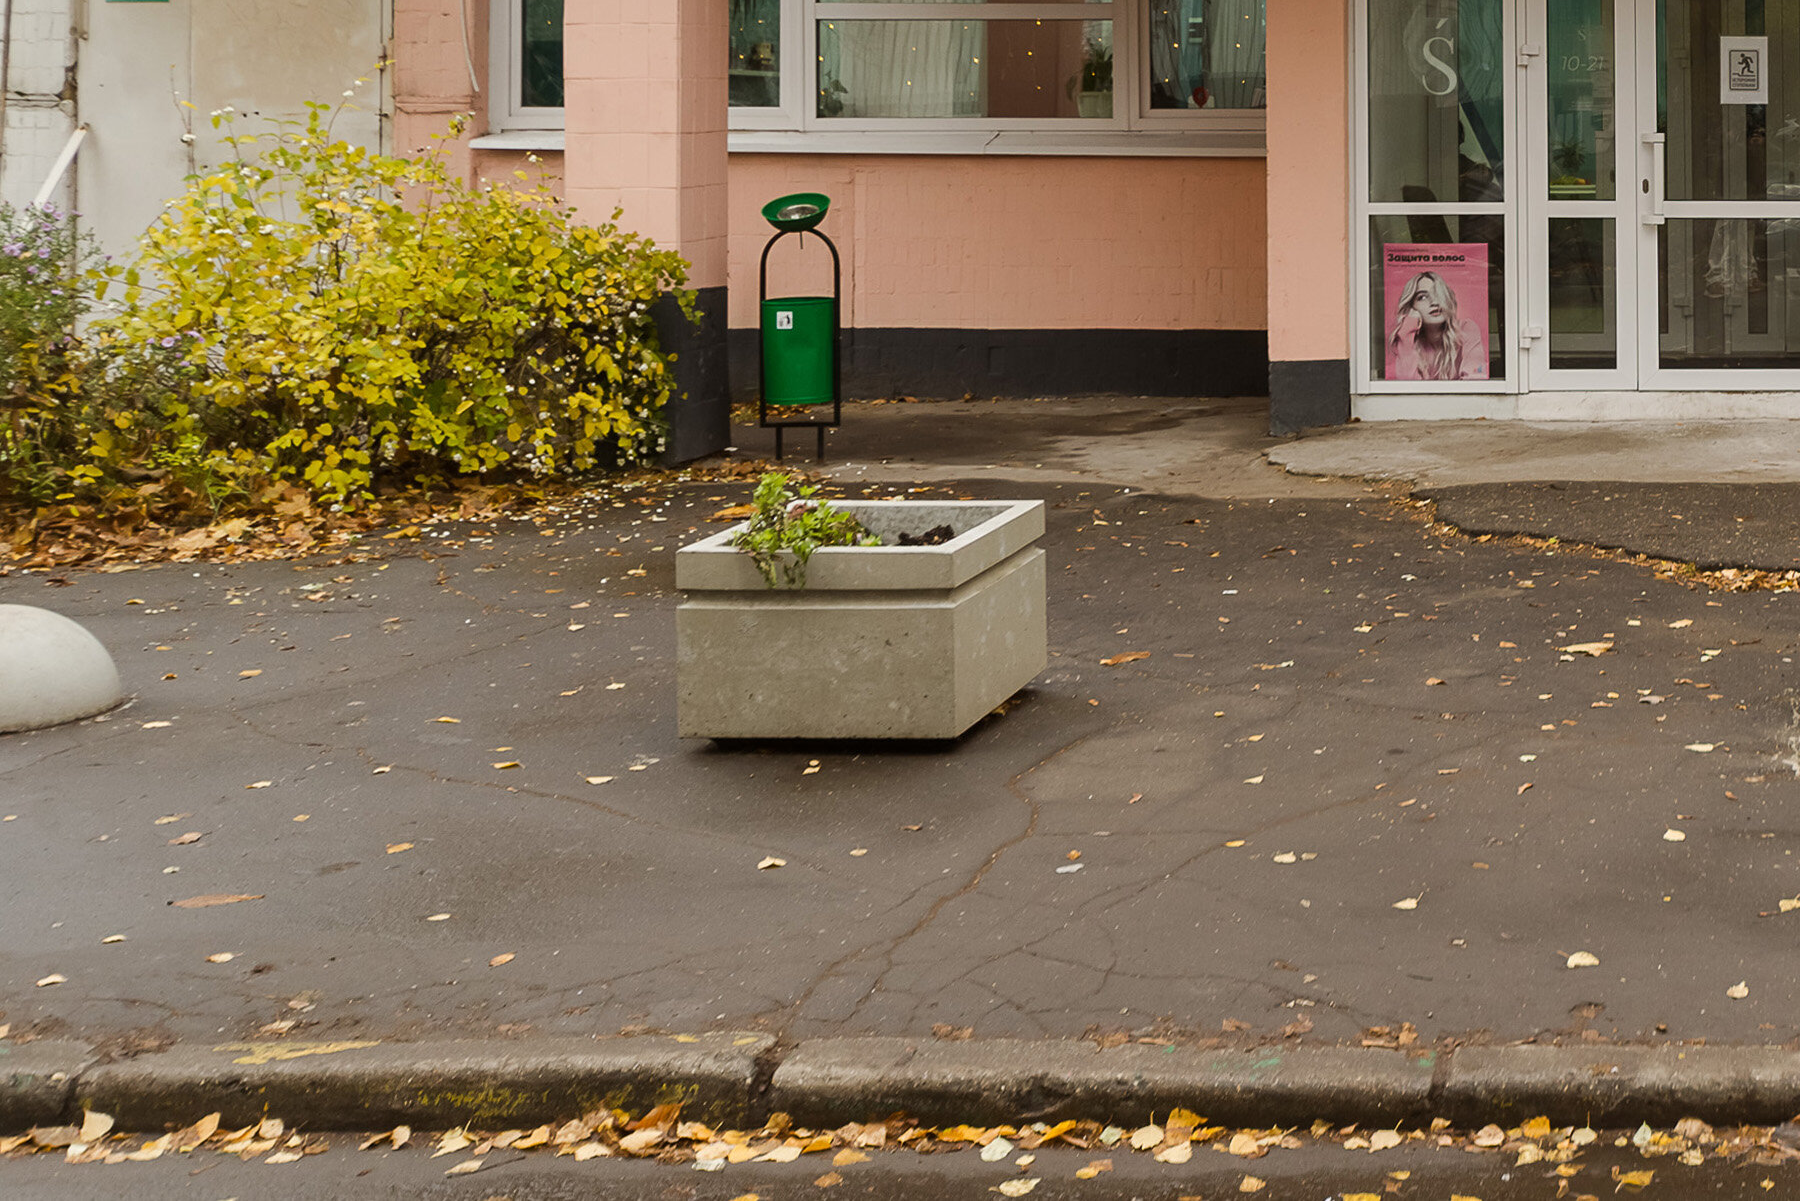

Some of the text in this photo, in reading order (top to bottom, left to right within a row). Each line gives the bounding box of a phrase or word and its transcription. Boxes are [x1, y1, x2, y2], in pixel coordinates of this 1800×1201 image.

[1561, 55, 1605, 72] 10-21
[1387, 253, 1465, 263] Защита волос
